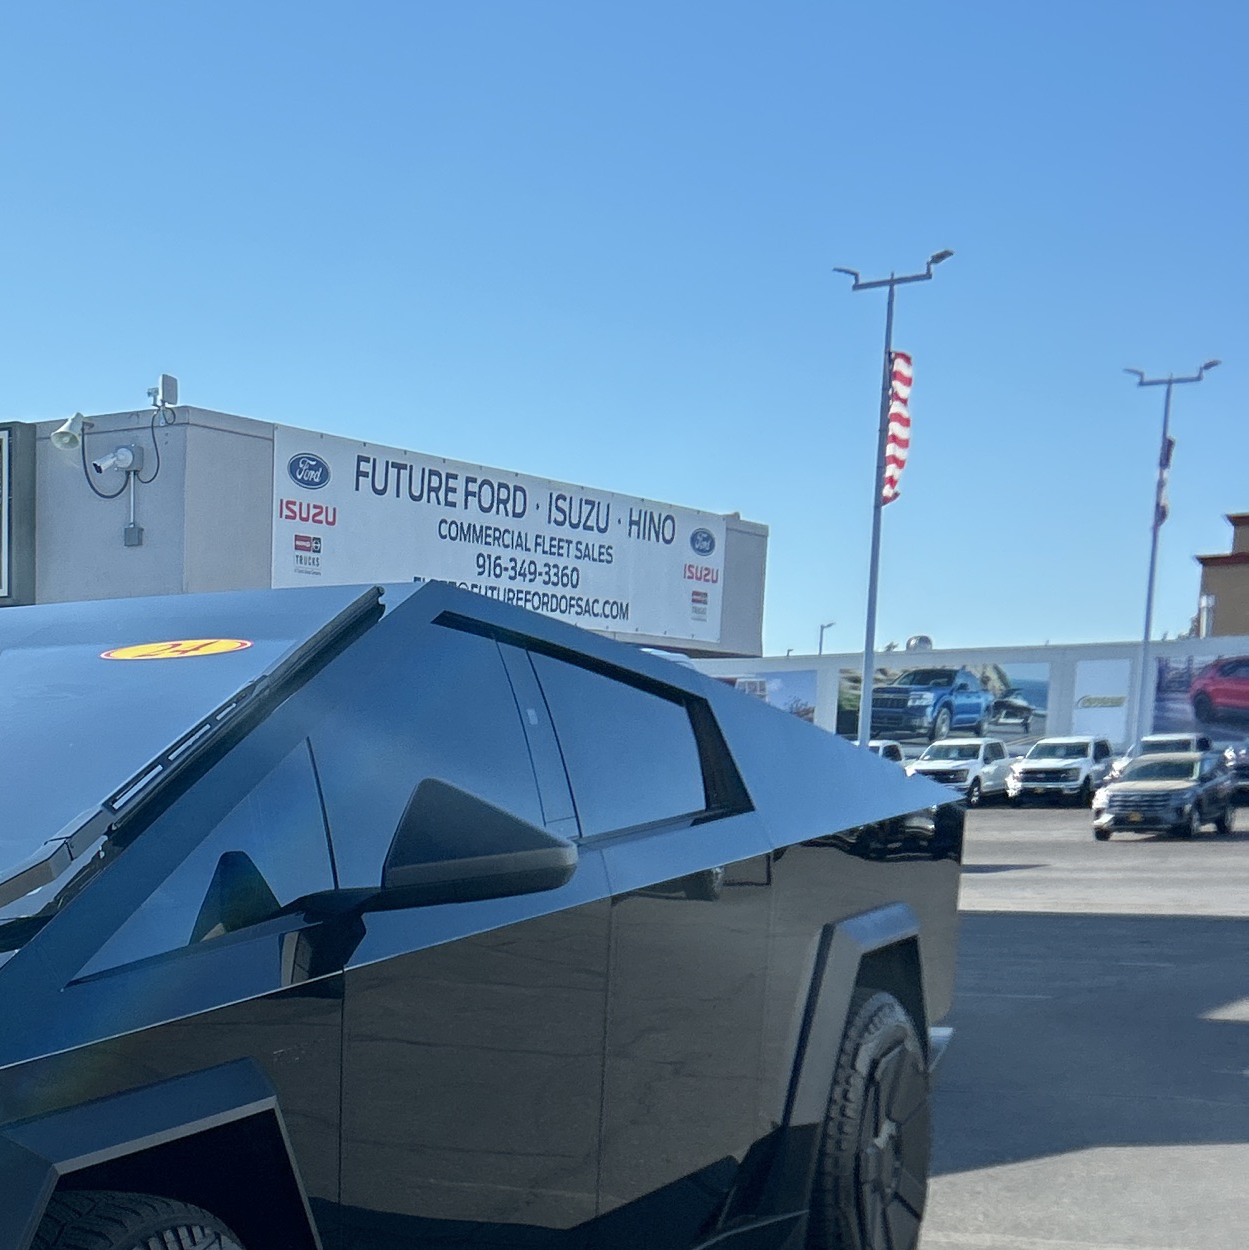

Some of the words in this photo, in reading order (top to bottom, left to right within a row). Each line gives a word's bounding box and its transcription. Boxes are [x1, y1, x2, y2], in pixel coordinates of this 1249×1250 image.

[279, 498, 336, 526] ISUZU
[354, 454, 458, 508] FUTURE
[464, 476, 527, 518] FORD
[548, 492, 610, 534] ISUZU
[628, 507, 676, 545] HINO
[438, 518, 531, 552] COMMERCIAL
[535, 534, 573, 558] FLEET
[574, 541, 613, 564] SALES
[476, 552, 580, 589] 916-349-3360
[683, 563, 719, 584] ISUZU
